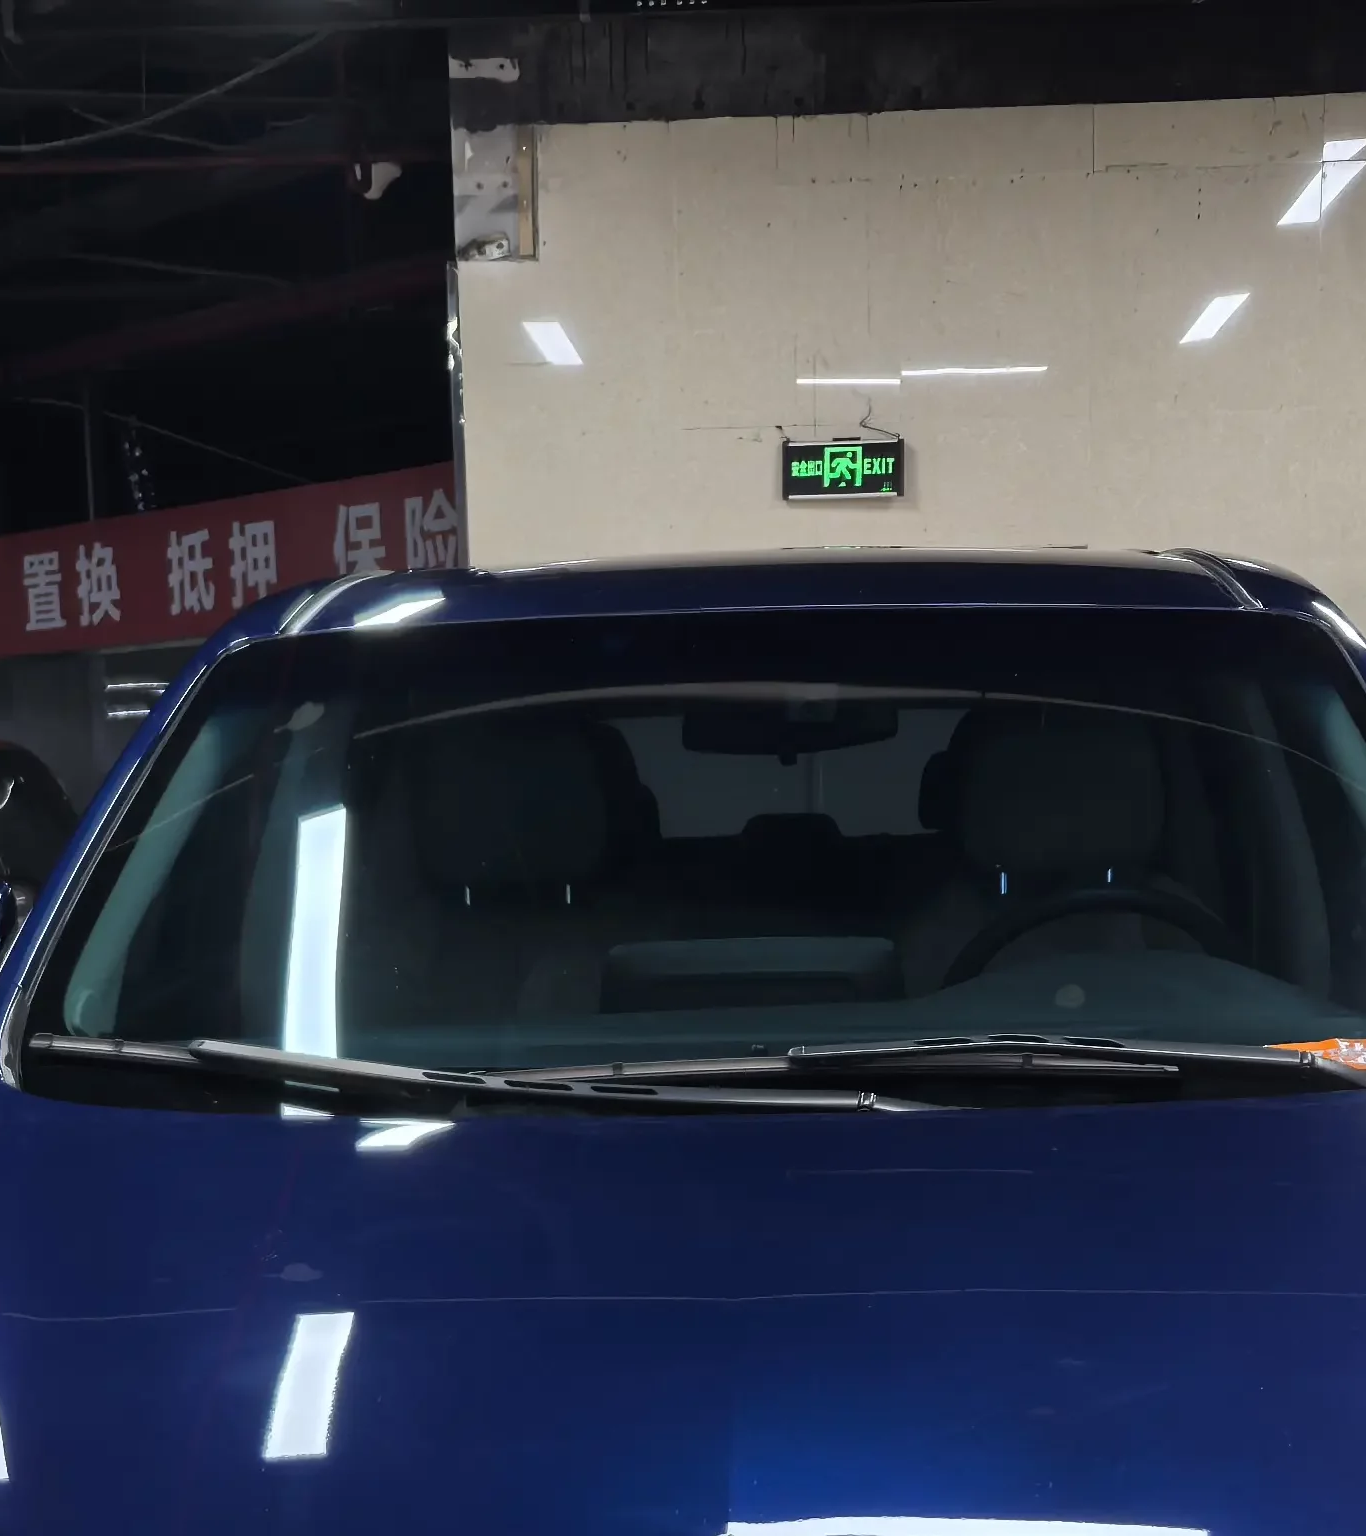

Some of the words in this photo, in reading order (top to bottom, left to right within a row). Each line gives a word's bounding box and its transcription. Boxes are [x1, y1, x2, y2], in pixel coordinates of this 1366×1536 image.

[863, 457, 895, 475] EXIT
[22, 541, 122, 632] 置换
[167, 520, 278, 616] 抵押
[333, 488, 460, 576] 保险
